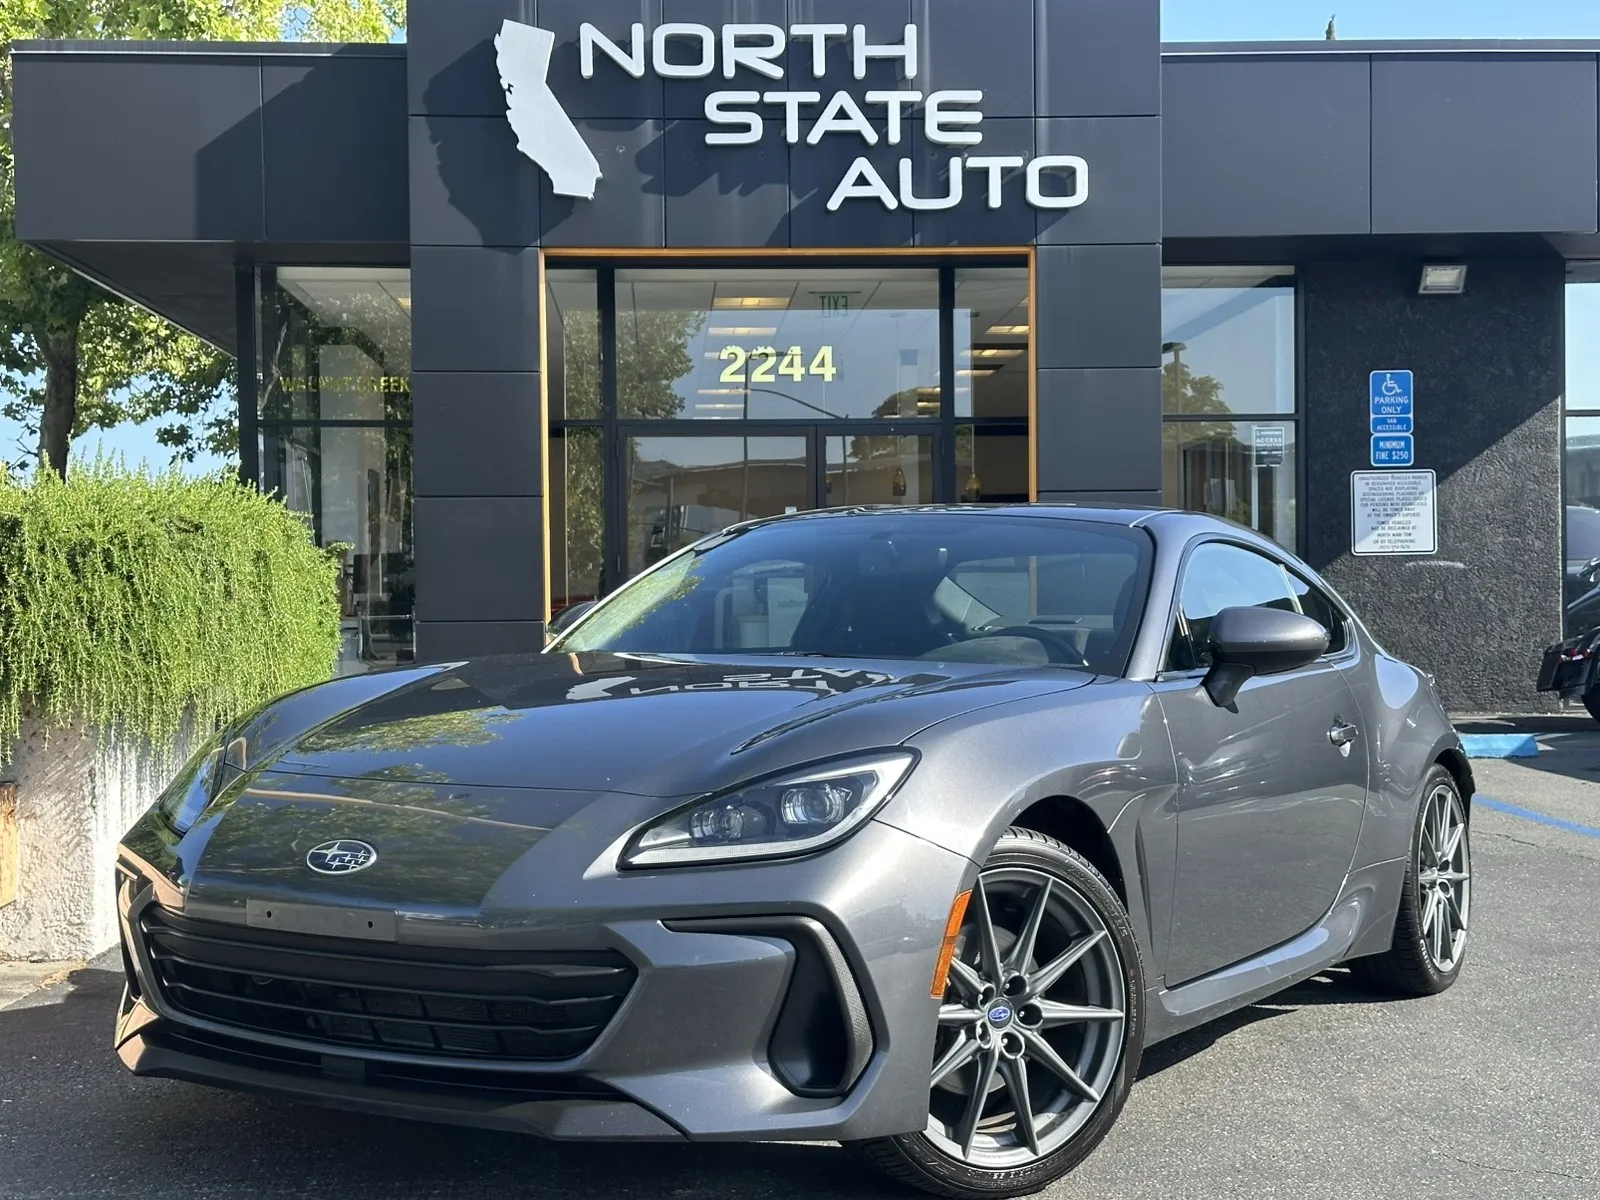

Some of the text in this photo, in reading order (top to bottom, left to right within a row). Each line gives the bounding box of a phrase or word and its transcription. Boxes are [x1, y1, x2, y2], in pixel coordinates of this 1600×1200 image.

[579, 22, 918, 80] NORTH
[704, 90, 984, 146] STATE
[826, 155, 1090, 212] AUTO
[718, 344, 837, 383] 2244
[356, 376, 411, 392] CREEK
[1374, 396, 1409, 405] PARKING
[1381, 406, 1402, 414] ONLY
[1379, 440, 1405, 449] MINIMUM
[1375, 450, 1409, 460] FINE $250
